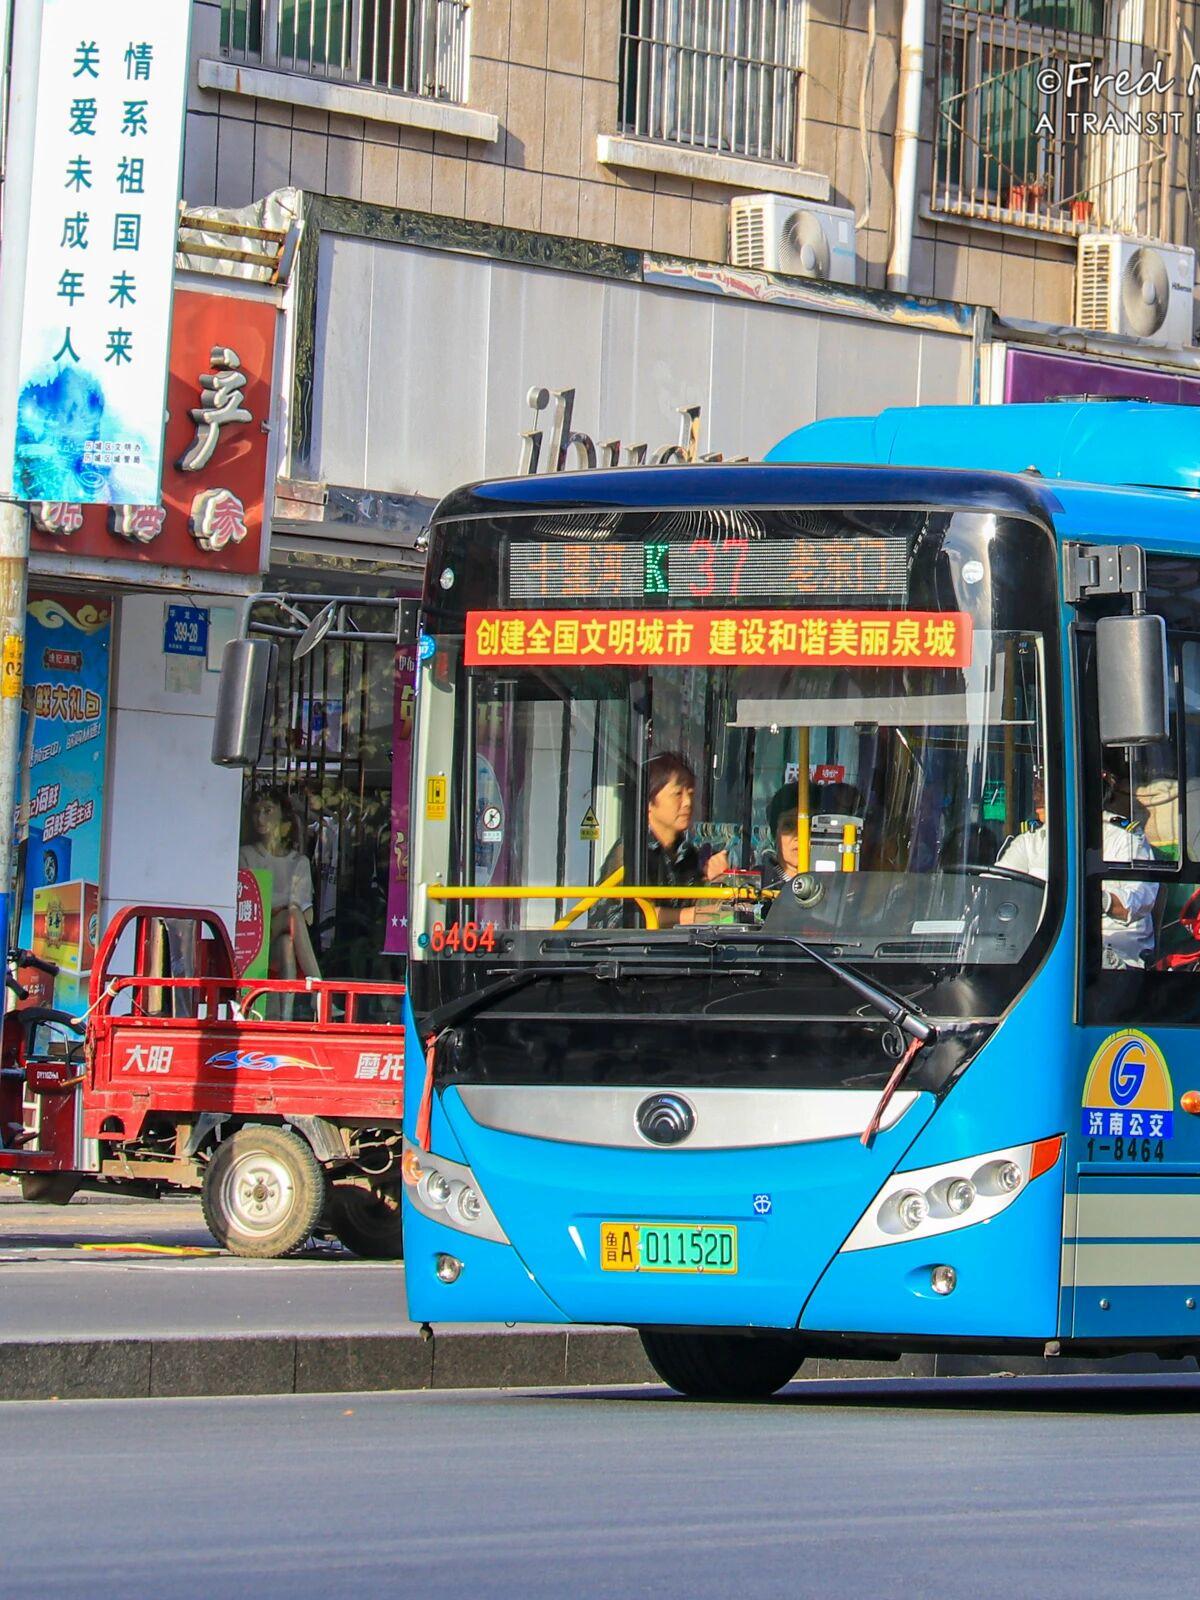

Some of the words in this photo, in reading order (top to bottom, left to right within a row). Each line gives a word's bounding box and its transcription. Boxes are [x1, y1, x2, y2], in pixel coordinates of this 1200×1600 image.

[52, 40, 101, 364] 关爱未成年人
[104, 41, 154, 366] 情系祖国未来
[174, 621, 198, 643] 399-28
[476, 618, 693, 656] 创建全国文明城市
[709, 618, 957, 658] 建设和谐美丽泉城
[431, 921, 496, 953] 8464
[121, 1045, 174, 1074] 大阳
[353, 1053, 404, 1082] 摩托
[1088, 1111, 1164, 1138] 济南公交
[1087, 1136, 1164, 1162] 1-8464
